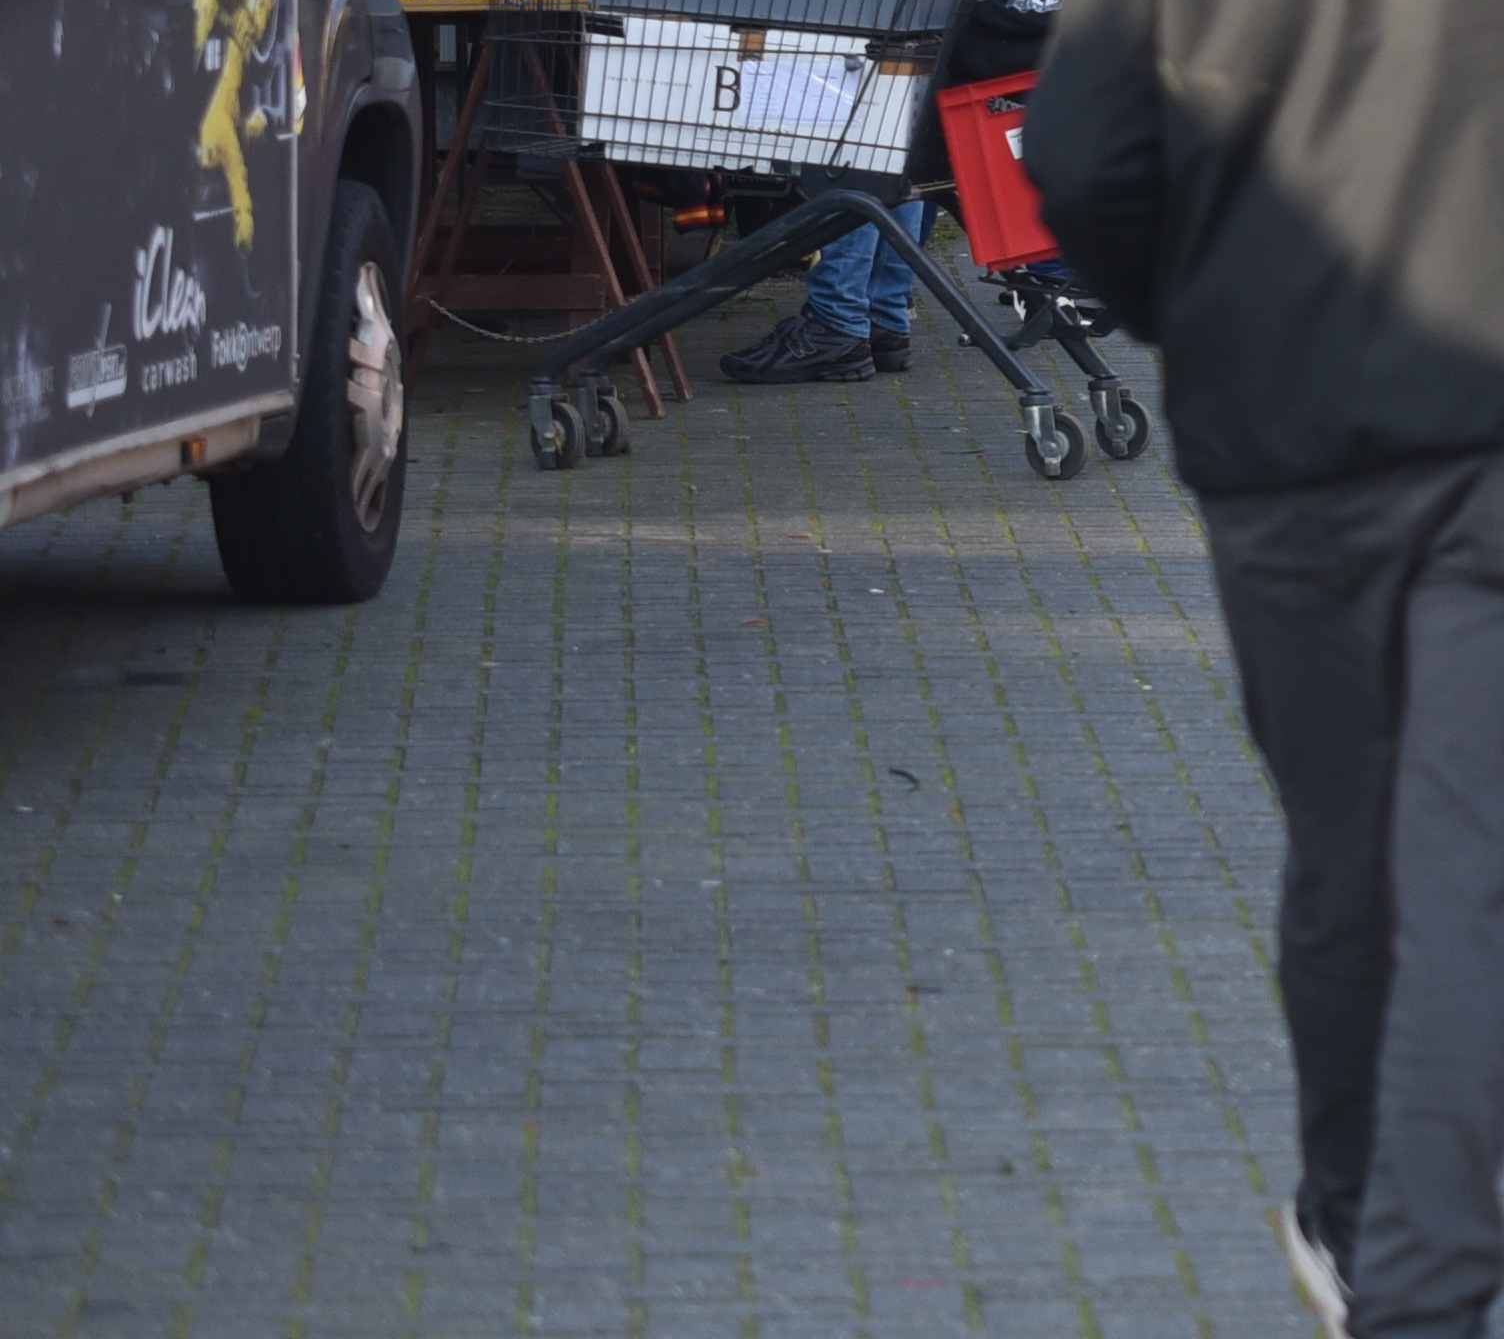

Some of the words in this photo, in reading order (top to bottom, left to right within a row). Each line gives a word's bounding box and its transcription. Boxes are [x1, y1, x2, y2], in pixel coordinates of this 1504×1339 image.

[713, 65, 742, 112] B
[133, 225, 207, 341] iClean
[141, 346, 198, 393] carwash
